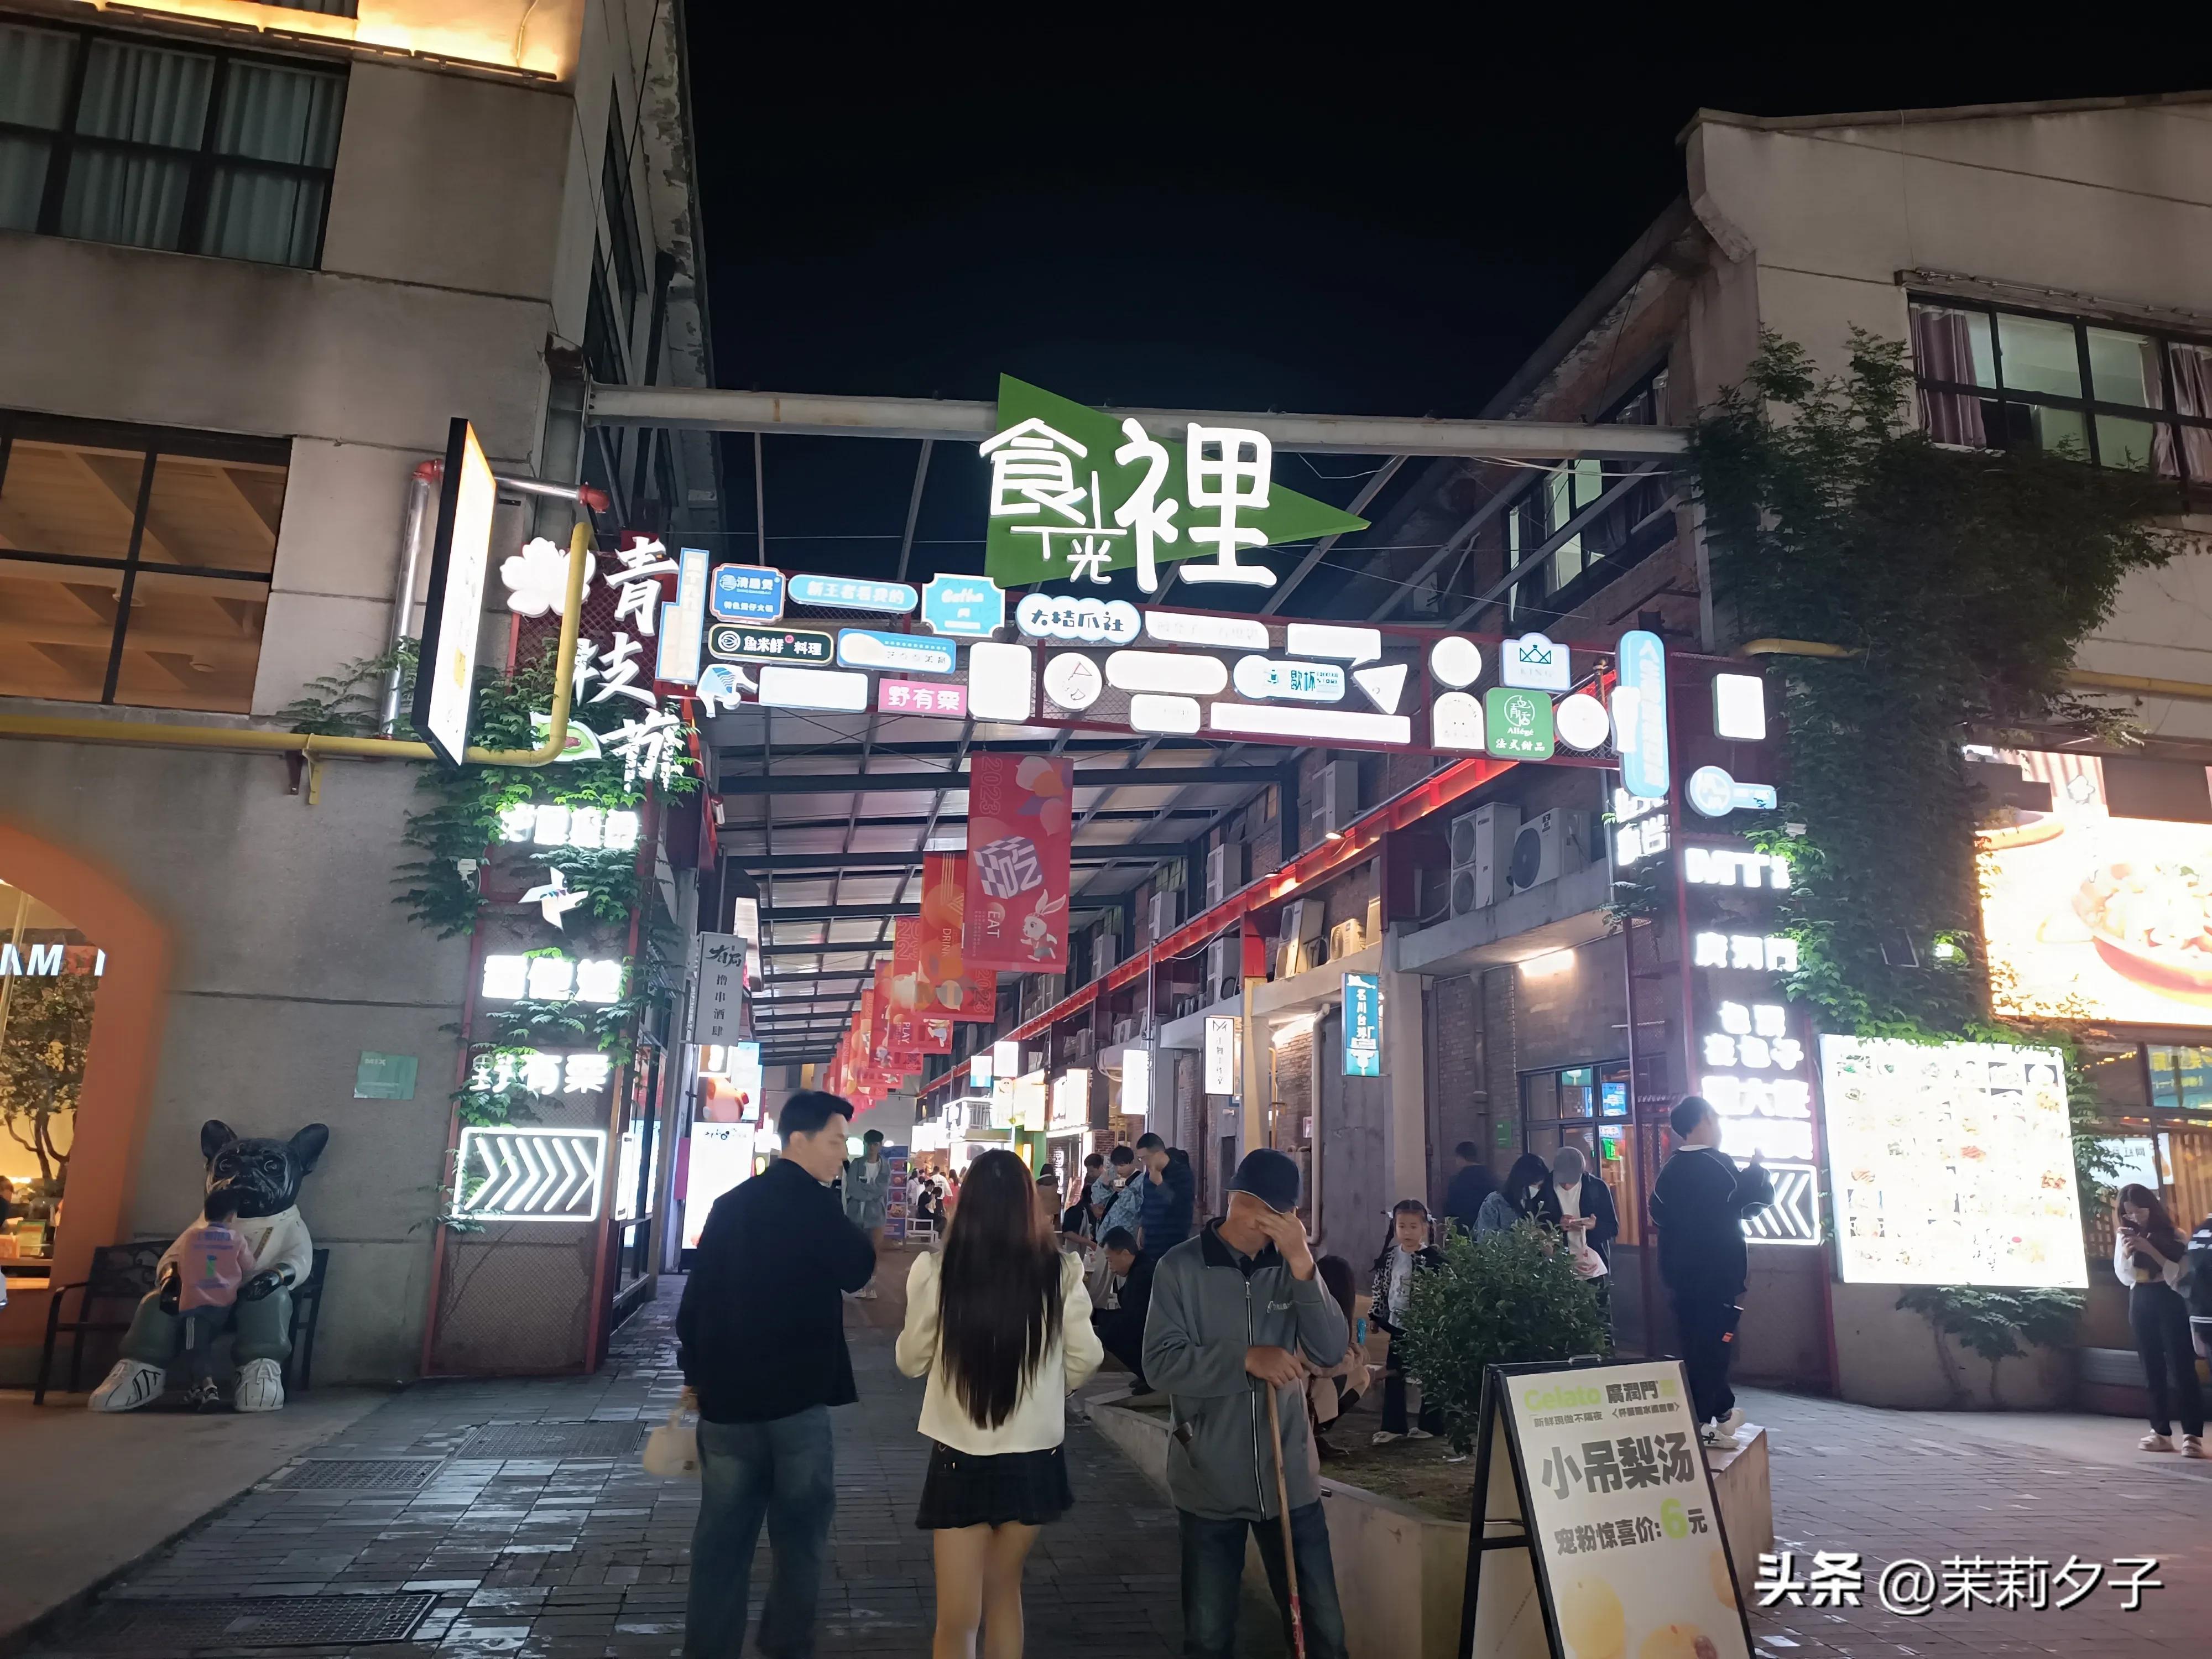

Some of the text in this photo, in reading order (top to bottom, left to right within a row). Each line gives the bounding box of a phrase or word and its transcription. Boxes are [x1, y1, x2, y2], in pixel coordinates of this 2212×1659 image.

[794, 641, 822, 656] 料理
[1495, 738, 1546, 752] 法式甜品
[987, 911, 1001, 938] EAT
[901, 1021, 911, 1045] PLAY
[1524, 1385, 1601, 1411] Gelato
[1541, 1432, 1695, 1500] 小吊梨汤
